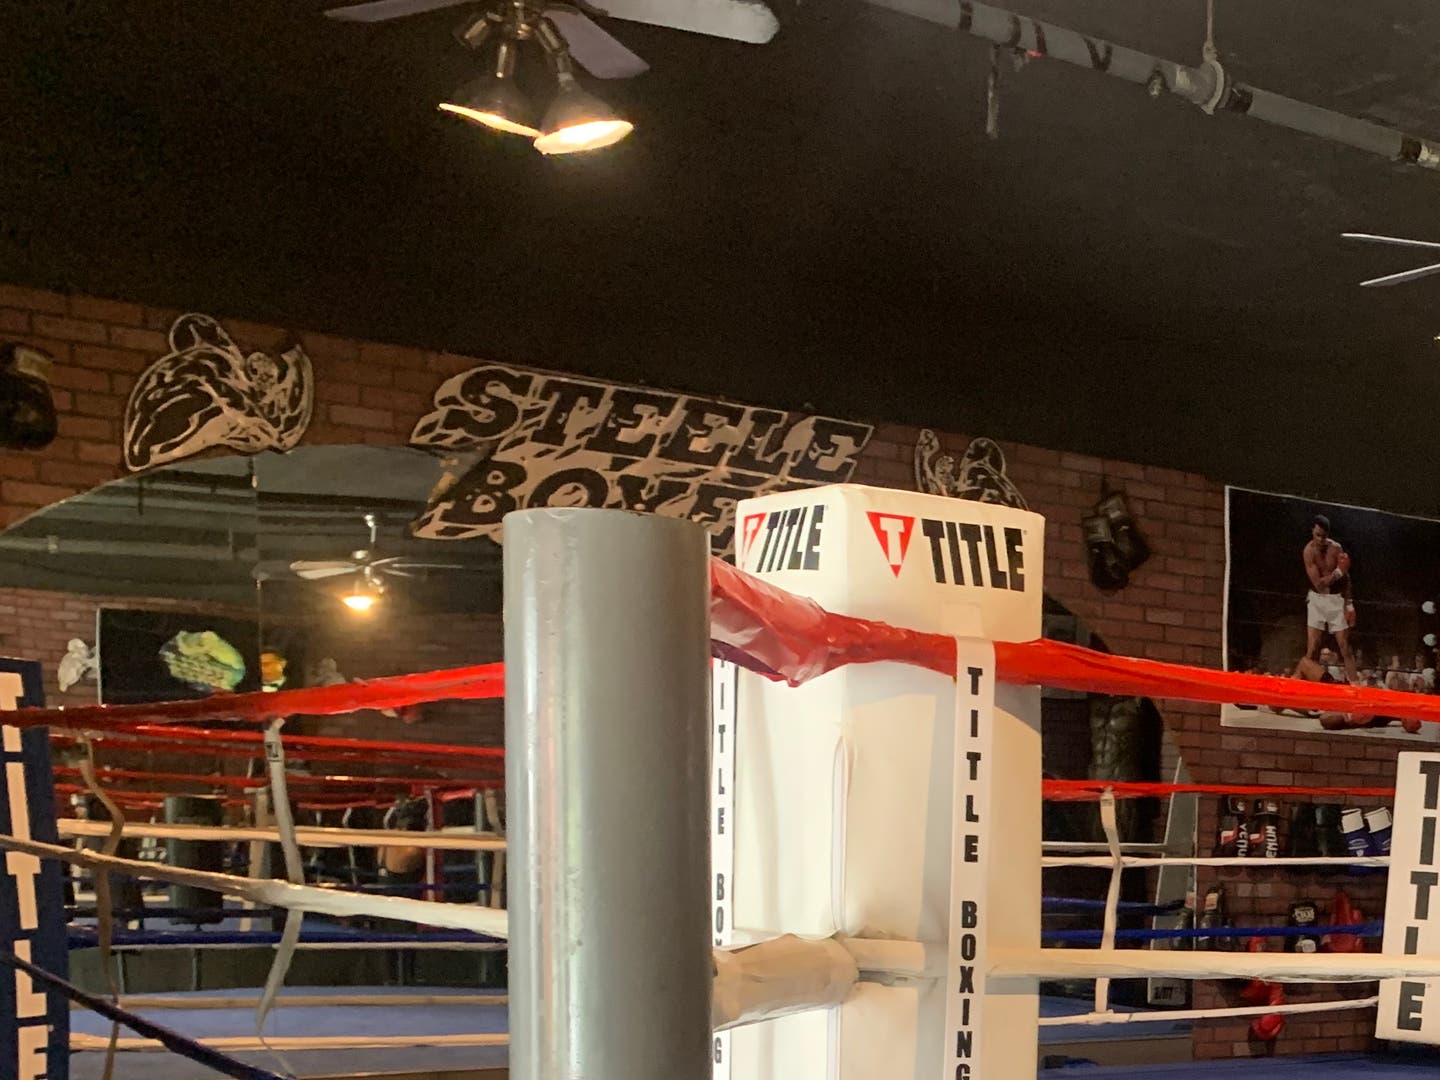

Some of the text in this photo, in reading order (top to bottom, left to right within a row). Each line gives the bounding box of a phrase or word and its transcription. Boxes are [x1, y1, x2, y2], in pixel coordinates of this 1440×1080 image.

[756, 504, 824, 573] TITLE
[921, 518, 1025, 592] TITLE
[964, 666, 983, 863] TITLE
